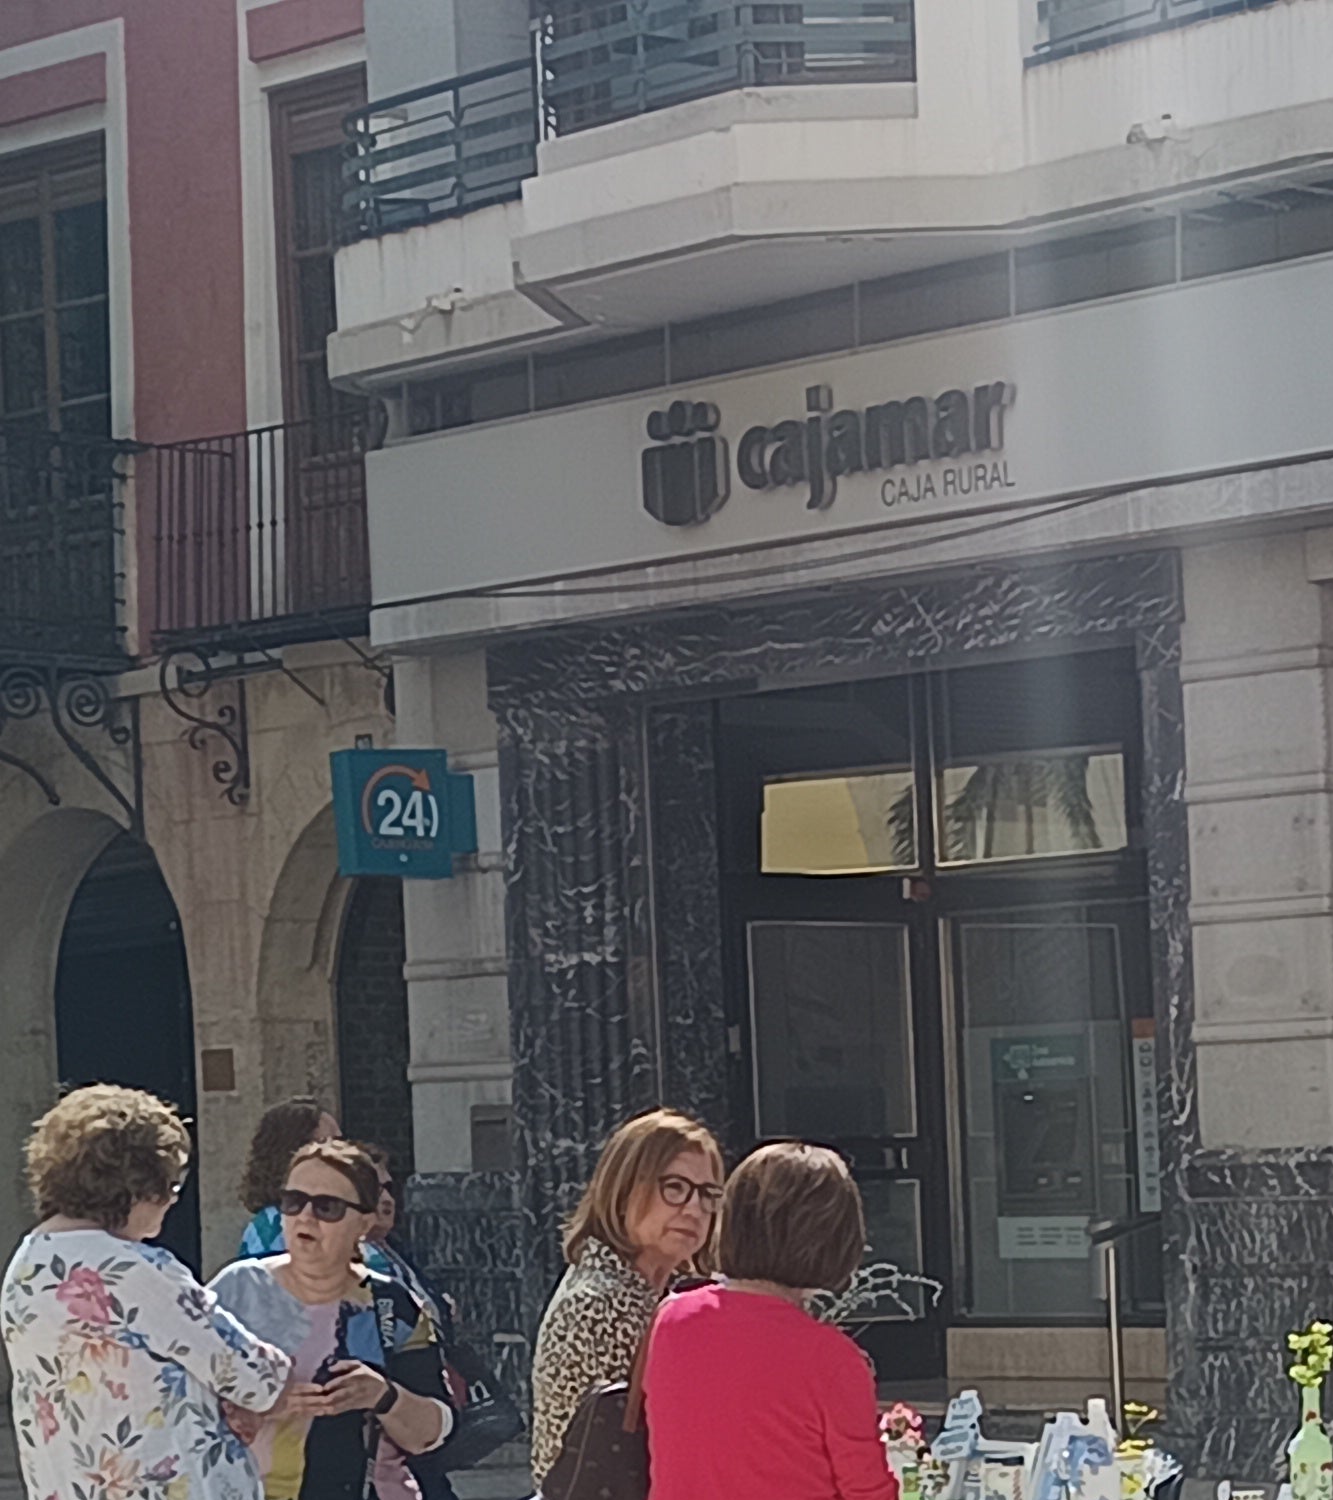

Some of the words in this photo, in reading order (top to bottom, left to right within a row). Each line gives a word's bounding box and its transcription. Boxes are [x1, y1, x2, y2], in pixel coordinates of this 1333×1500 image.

[736, 380, 1014, 510] cajamar
[880, 476, 937, 507] CAJA
[943, 460, 1017, 497] RURAL
